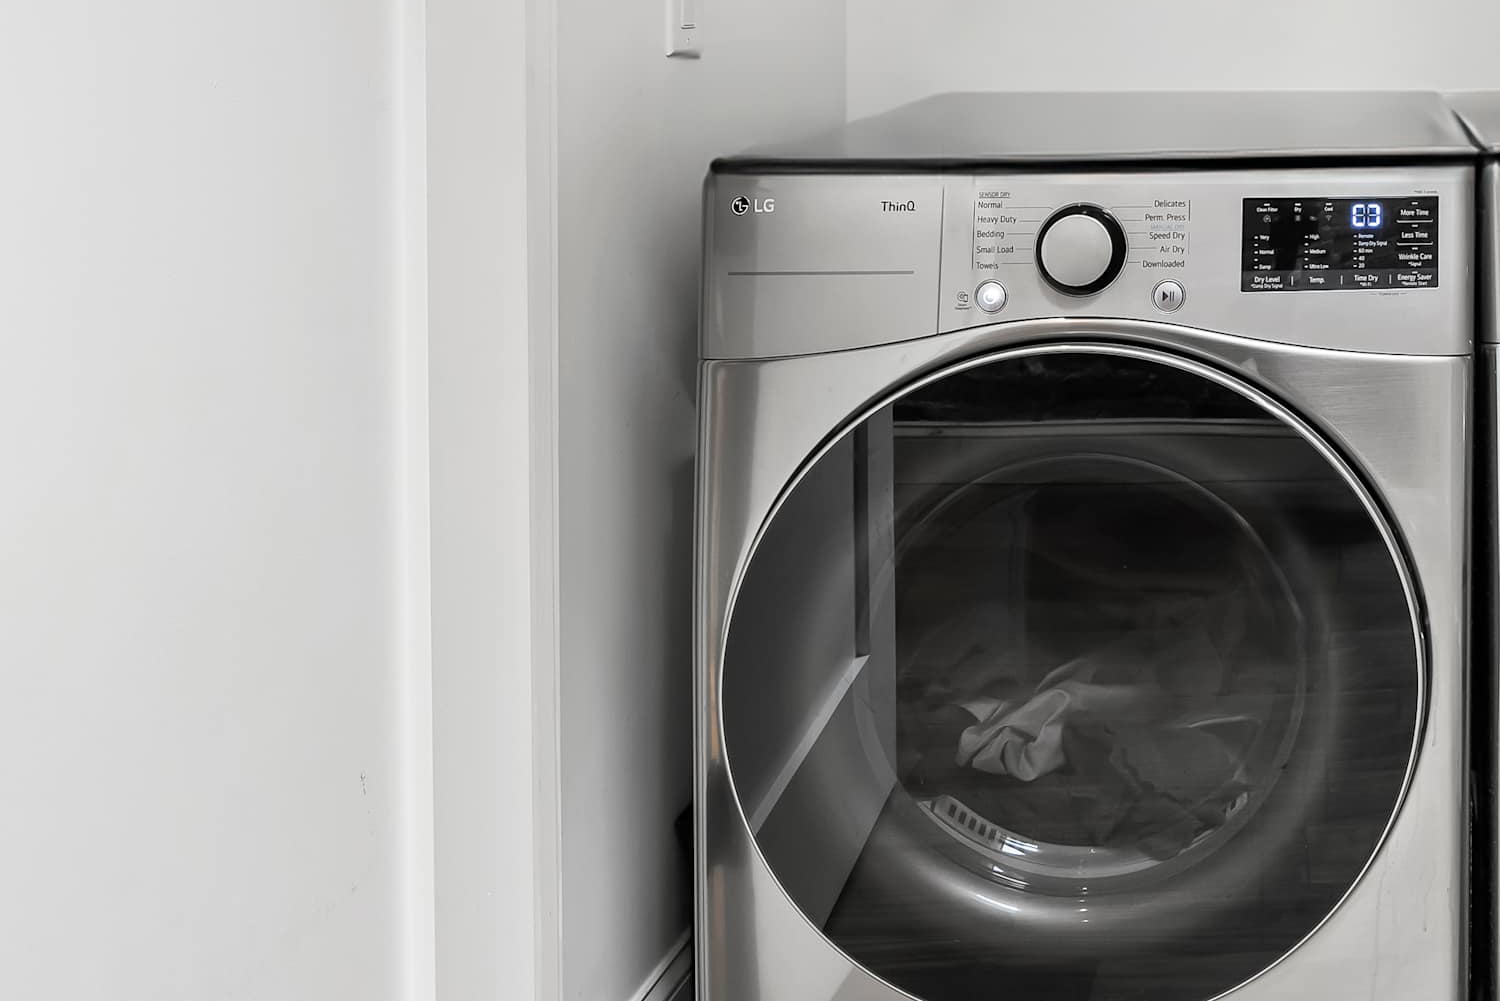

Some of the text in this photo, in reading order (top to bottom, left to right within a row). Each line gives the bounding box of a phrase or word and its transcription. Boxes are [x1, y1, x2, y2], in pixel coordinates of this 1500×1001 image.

[753, 198, 775, 213] LG
[881, 200, 915, 212] ThinQ
[1154, 200, 1186, 208] Delicates
[978, 215, 1016, 224] Heavy Duty
[1167, 213, 1185, 221] Press
[977, 230, 1004, 239] Bedding
[1149, 232, 1185, 240] Speed Dry
[976, 246, 1014, 254] Small Load
[1160, 245, 1184, 254] Air Dry
[976, 261, 999, 269] Towels
[1143, 260, 1185, 268] Downloaded
[1254, 276, 1264, 284] Dry
[1368, 274, 1378, 283] Dry
[1397, 273, 1432, 281] Energy Saver
